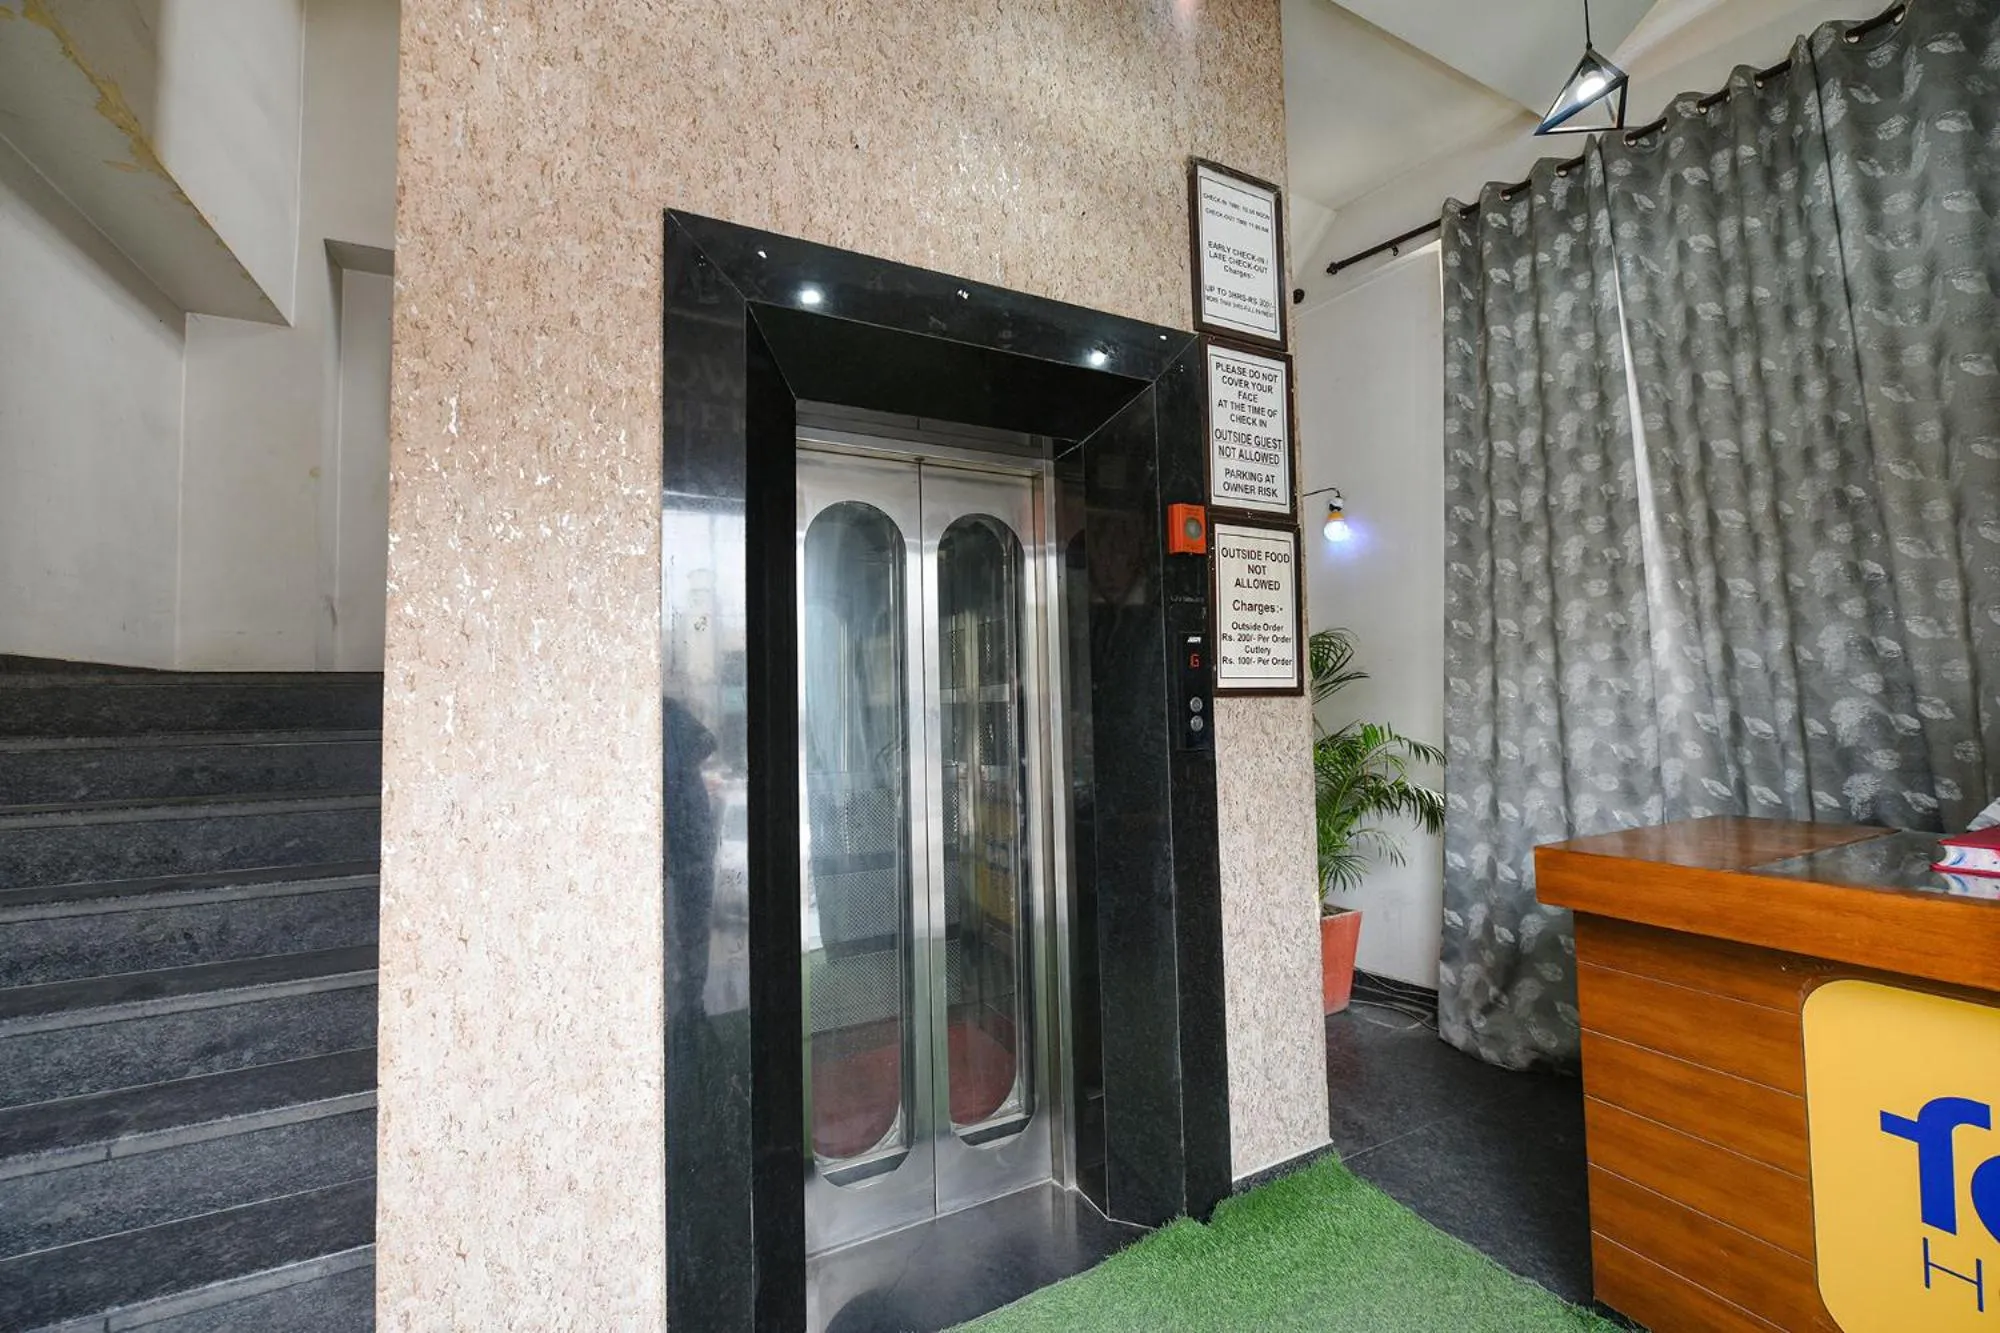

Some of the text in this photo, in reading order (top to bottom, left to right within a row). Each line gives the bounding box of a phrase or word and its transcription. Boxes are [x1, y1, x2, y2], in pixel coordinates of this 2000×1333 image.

[1208, 241, 1231, 253] EARLY
[1209, 250, 1268, 274] LATE CHECK-OUT
[1218, 288, 1227, 296] TO
[1216, 362, 1278, 383] PLEASE DO NOT
[1222, 375, 1273, 394] COVER YOUR
[1238, 391, 1258, 403] FACE
[1218, 399, 1278, 418] AT THE TIME OF
[1230, 413, 1267, 428] CHECK IN
[1214, 428, 1282, 450] OUTSIDE GUEST
[1218, 445, 1280, 465] NOT ALLOWED
[1224, 468, 1276, 484] PARKING AT
[1223, 481, 1278, 498] OWNER RISK
[1221, 547, 1290, 564] OUTSIDE FOOD
[1248, 564, 1267, 576] NOT
[1234, 578, 1280, 591] ALLOWED
[1232, 599, 1283, 615] Charges:-
[1232, 621, 1284, 632] Outside Order
[1222, 632, 1235, 642] Rs.
[1258, 634, 1270, 643] Per
[1272, 634, 1291, 643] Order
[1244, 645, 1271, 656] Cutlery
[1222, 656, 1235, 664] Rs.
[1257, 656, 1270, 665] Per
[1272, 656, 1292, 666] Order
